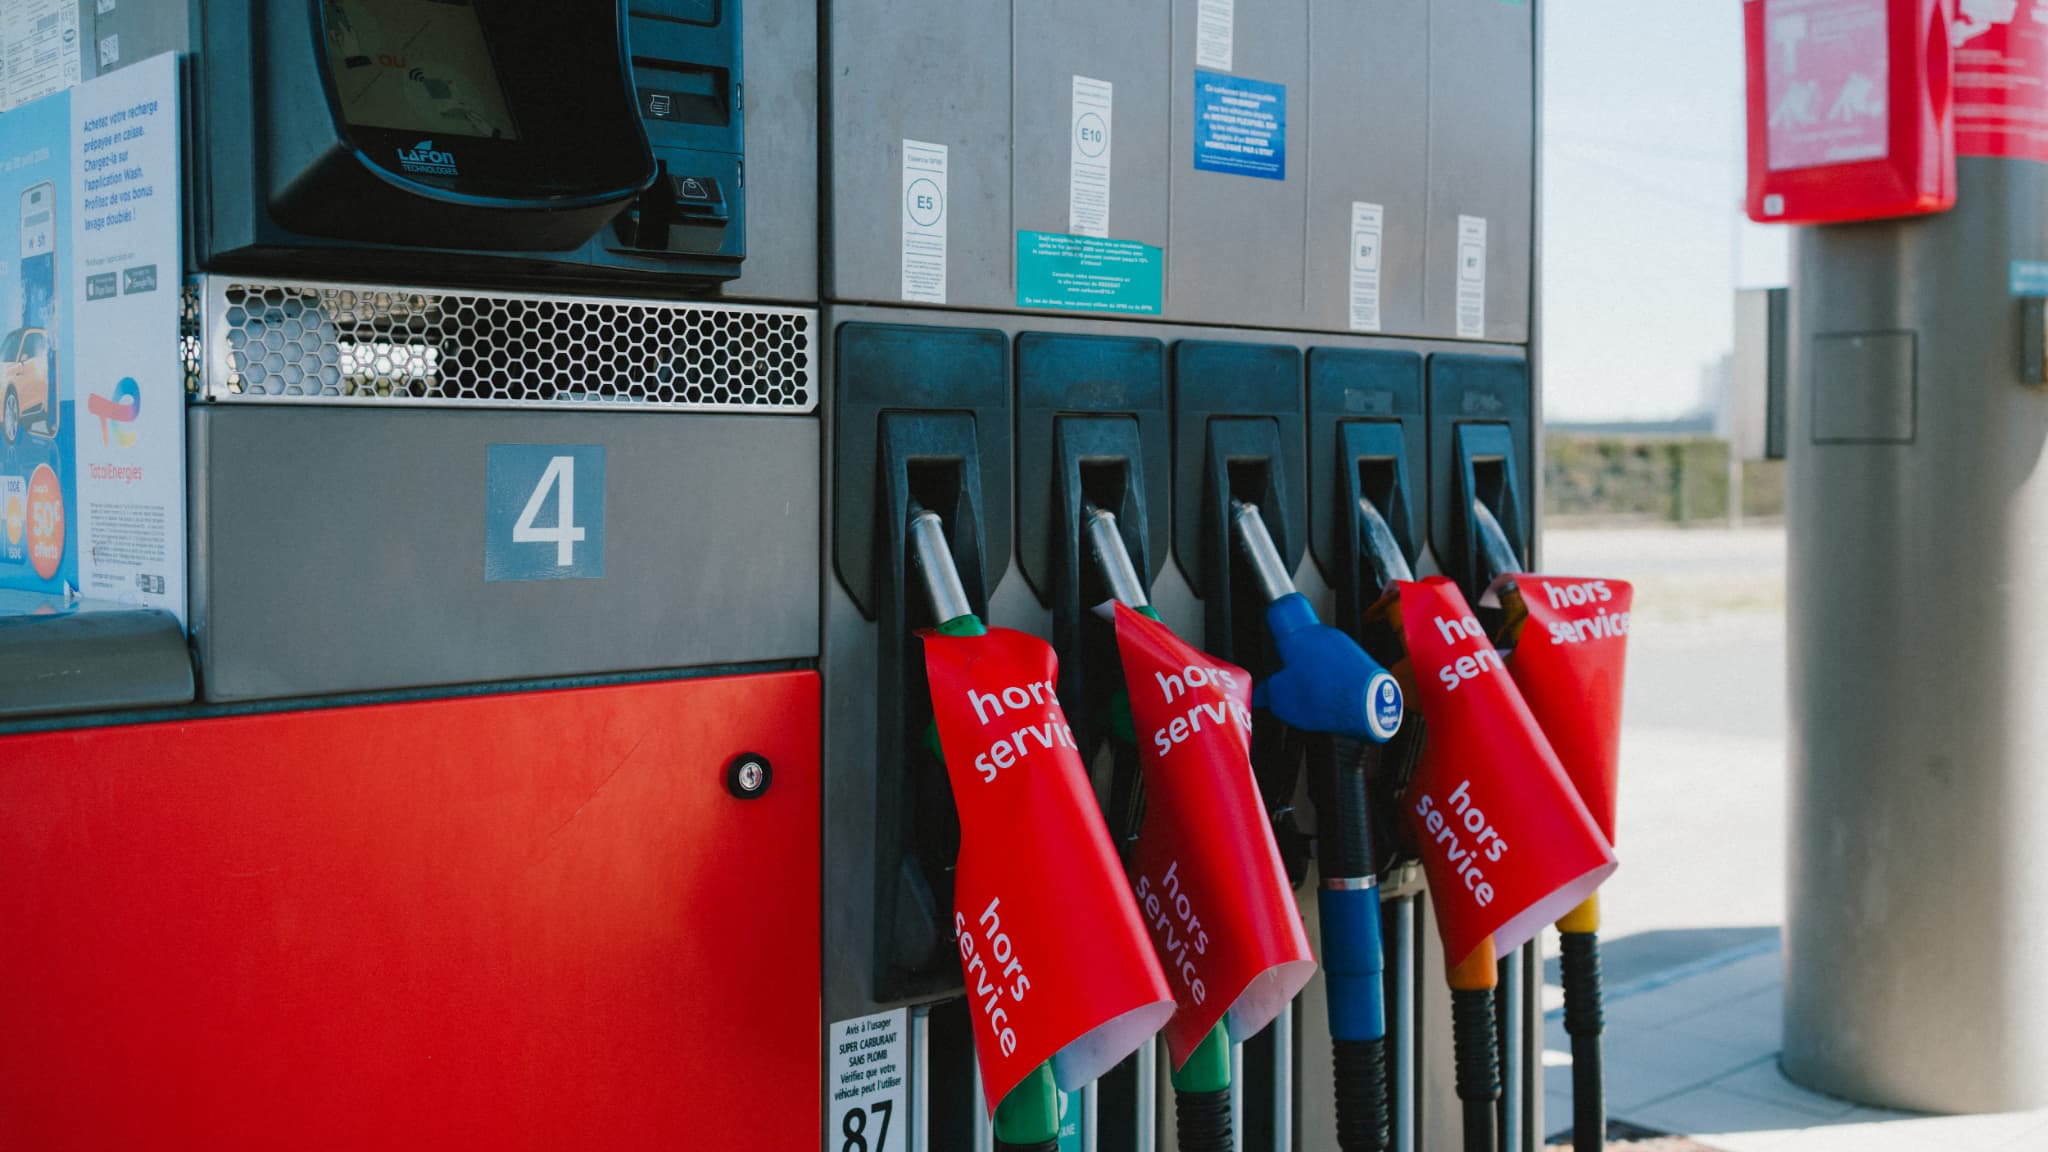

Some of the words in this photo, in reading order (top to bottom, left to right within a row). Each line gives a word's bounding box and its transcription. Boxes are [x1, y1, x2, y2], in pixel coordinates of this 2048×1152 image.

[84, 115, 108, 132] Achetez
[109, 111, 126, 125] votre
[127, 100, 158, 119] recharge
[113, 133, 121, 144] en
[1081, 127, 1102, 143] E10
[84, 172, 122, 192] l'application
[402, 164, 459, 177] TECHNOLOGIES
[84, 195, 109, 211] Profitez
[109, 191, 118, 205] de
[119, 190, 131, 202] vos
[132, 185, 153, 200] bonus
[916, 195, 933, 211] E5
[84, 217, 105, 232] lavage
[89, 463, 143, 485] TotalEnergies
[33, 500, 60, 537] 50€
[512, 456, 585, 566] 4
[34, 541, 58, 560] offerts
[1542, 581, 1612, 610] hors
[1434, 615, 1484, 646] ho
[1548, 607, 1632, 645] service
[1155, 665, 1239, 705] hors
[1439, 649, 1504, 692] serv
[1154, 693, 1252, 757] servic
[975, 712, 1078, 784] servic
[1448, 779, 1508, 862] hors
[1416, 794, 1494, 907] service
[1162, 860, 1209, 954] hors
[979, 896, 1031, 1002] hors
[1136, 874, 1206, 1006] service
[955, 911, 1017, 1058] service
[845, 1023, 859, 1036] Avis
[861, 1022, 866, 1033] à
[867, 1018, 892, 1031] l'usager
[839, 1041, 858, 1056] SUPER
[859, 1032, 898, 1050] CARBURANT
[848, 1054, 865, 1068] SANS
[866, 1049, 888, 1063] PLOMB
[834, 1085, 859, 1101] véhicule
[861, 1082, 875, 1097] peut
[877, 1077, 902, 1091] l'utiliser
[840, 1070, 864, 1084] Vérifiez
[866, 1068, 878, 1081] que
[880, 1063, 896, 1075] votre
[842, 1099, 893, 1152] 87
